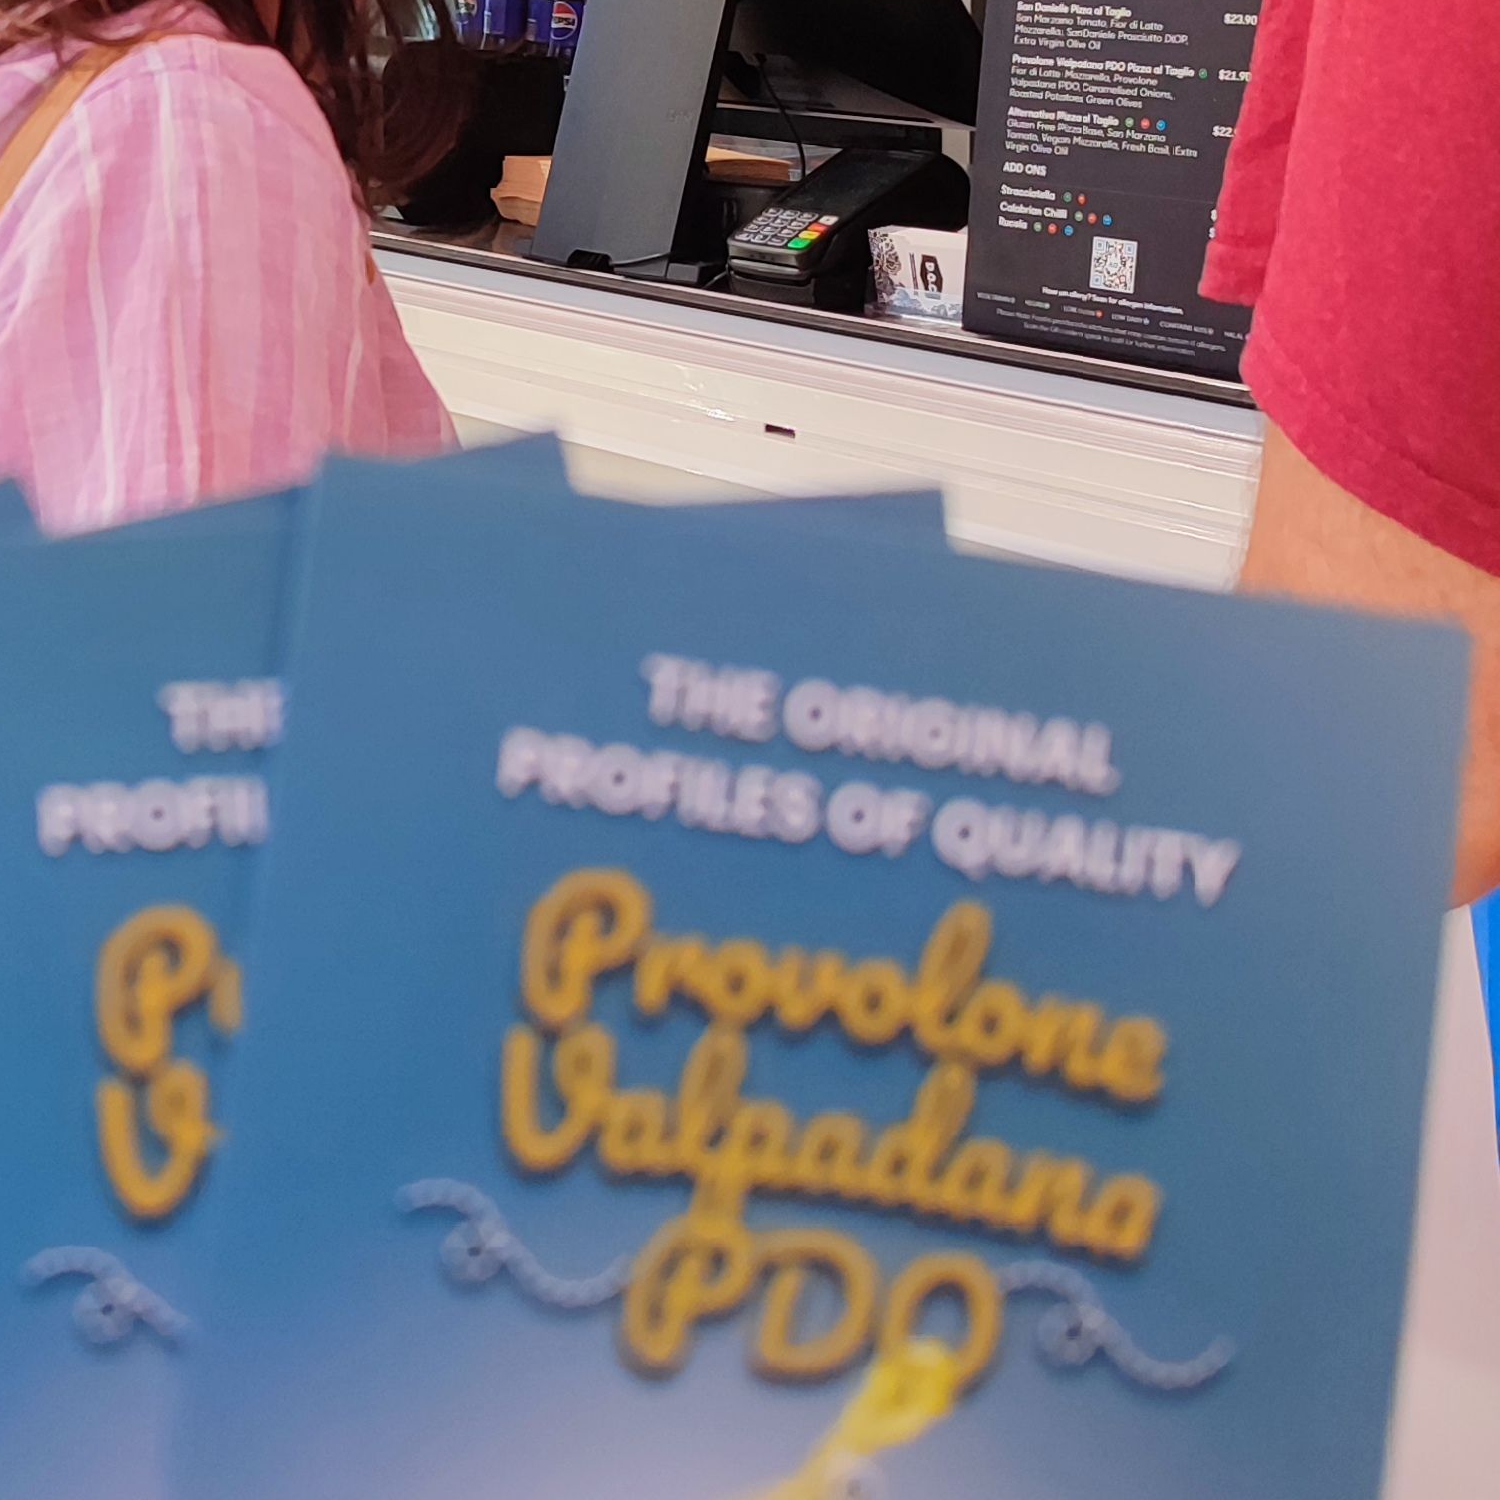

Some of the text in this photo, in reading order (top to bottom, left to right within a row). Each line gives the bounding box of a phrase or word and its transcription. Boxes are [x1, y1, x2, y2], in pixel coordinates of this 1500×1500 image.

[1105, 6, 1132, 19] Taglio
[1129, 20, 1138, 30] di
[1088, 40, 1101, 51] Oil
[1105, 60, 1126, 72] PDO
[1127, 62, 1152, 74] Pizza
[1164, 65, 1195, 79] Taglio
[1092, 113, 1120, 128] Taglio
[1003, 161, 1047, 177] ADD ONS
[641, 652, 1122, 795] THE ORIGINAL
[496, 725, 1242, 907] PROFILES OF QUALITY
[522, 867, 1167, 1100] Provolone
[503, 1023, 1163, 1258] Valpadana
[620, 1212, 1004, 1378] PDO
